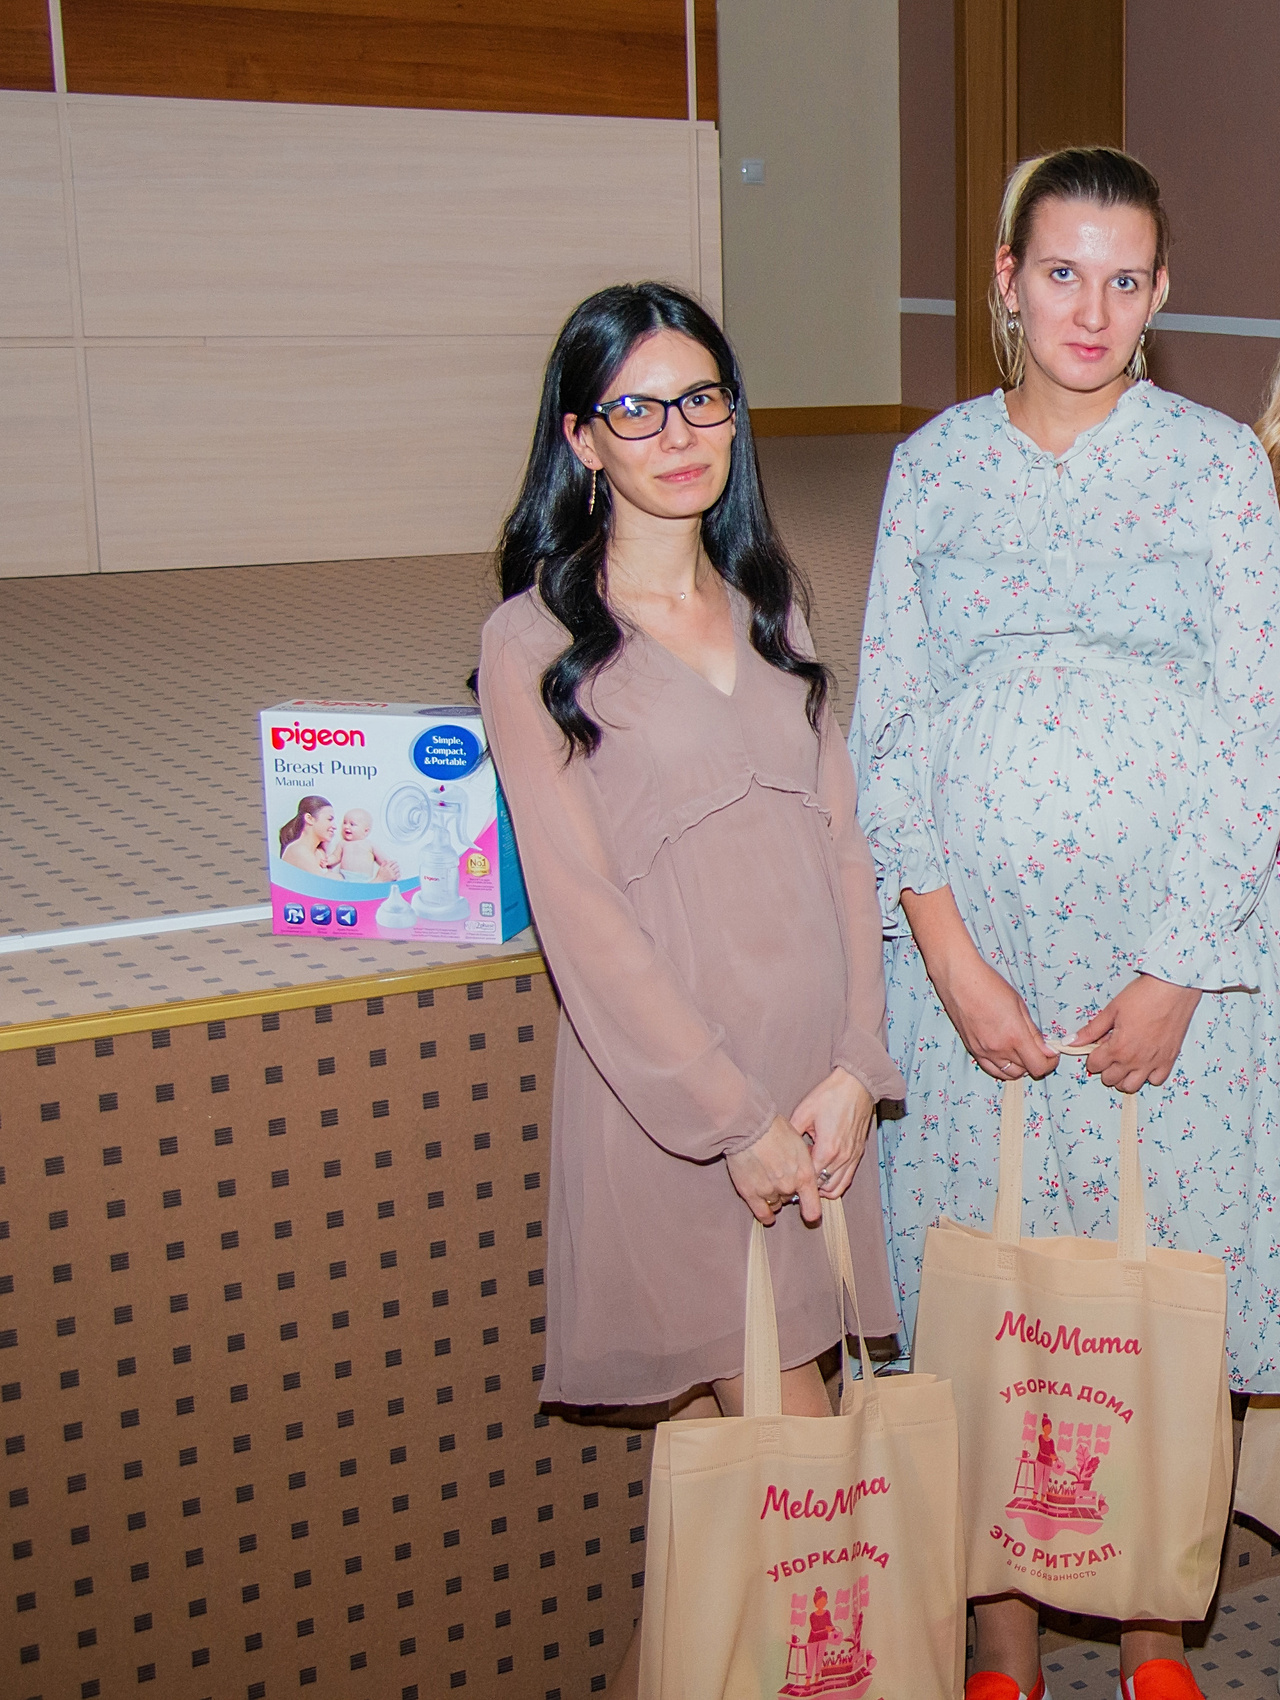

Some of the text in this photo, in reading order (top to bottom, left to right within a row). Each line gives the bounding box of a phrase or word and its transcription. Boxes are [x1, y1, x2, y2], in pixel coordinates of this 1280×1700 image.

[270, 721, 366, 752] pigeon
[432, 735, 464, 746] Simple,
[425, 745, 467, 757] Compact,
[274, 758, 378, 780] Breast Pump
[275, 776, 315, 787] Manual
[994, 1310, 1143, 1357] MeloMama
[999, 1378, 1134, 1424] УБОРКА ДОМА
[989, 1524, 1027, 1558] ЭТО
[766, 1547, 850, 1583] УБОРКА
[1014, 1563, 1027, 1573] не
[1030, 1569, 1097, 1582] обязанность
